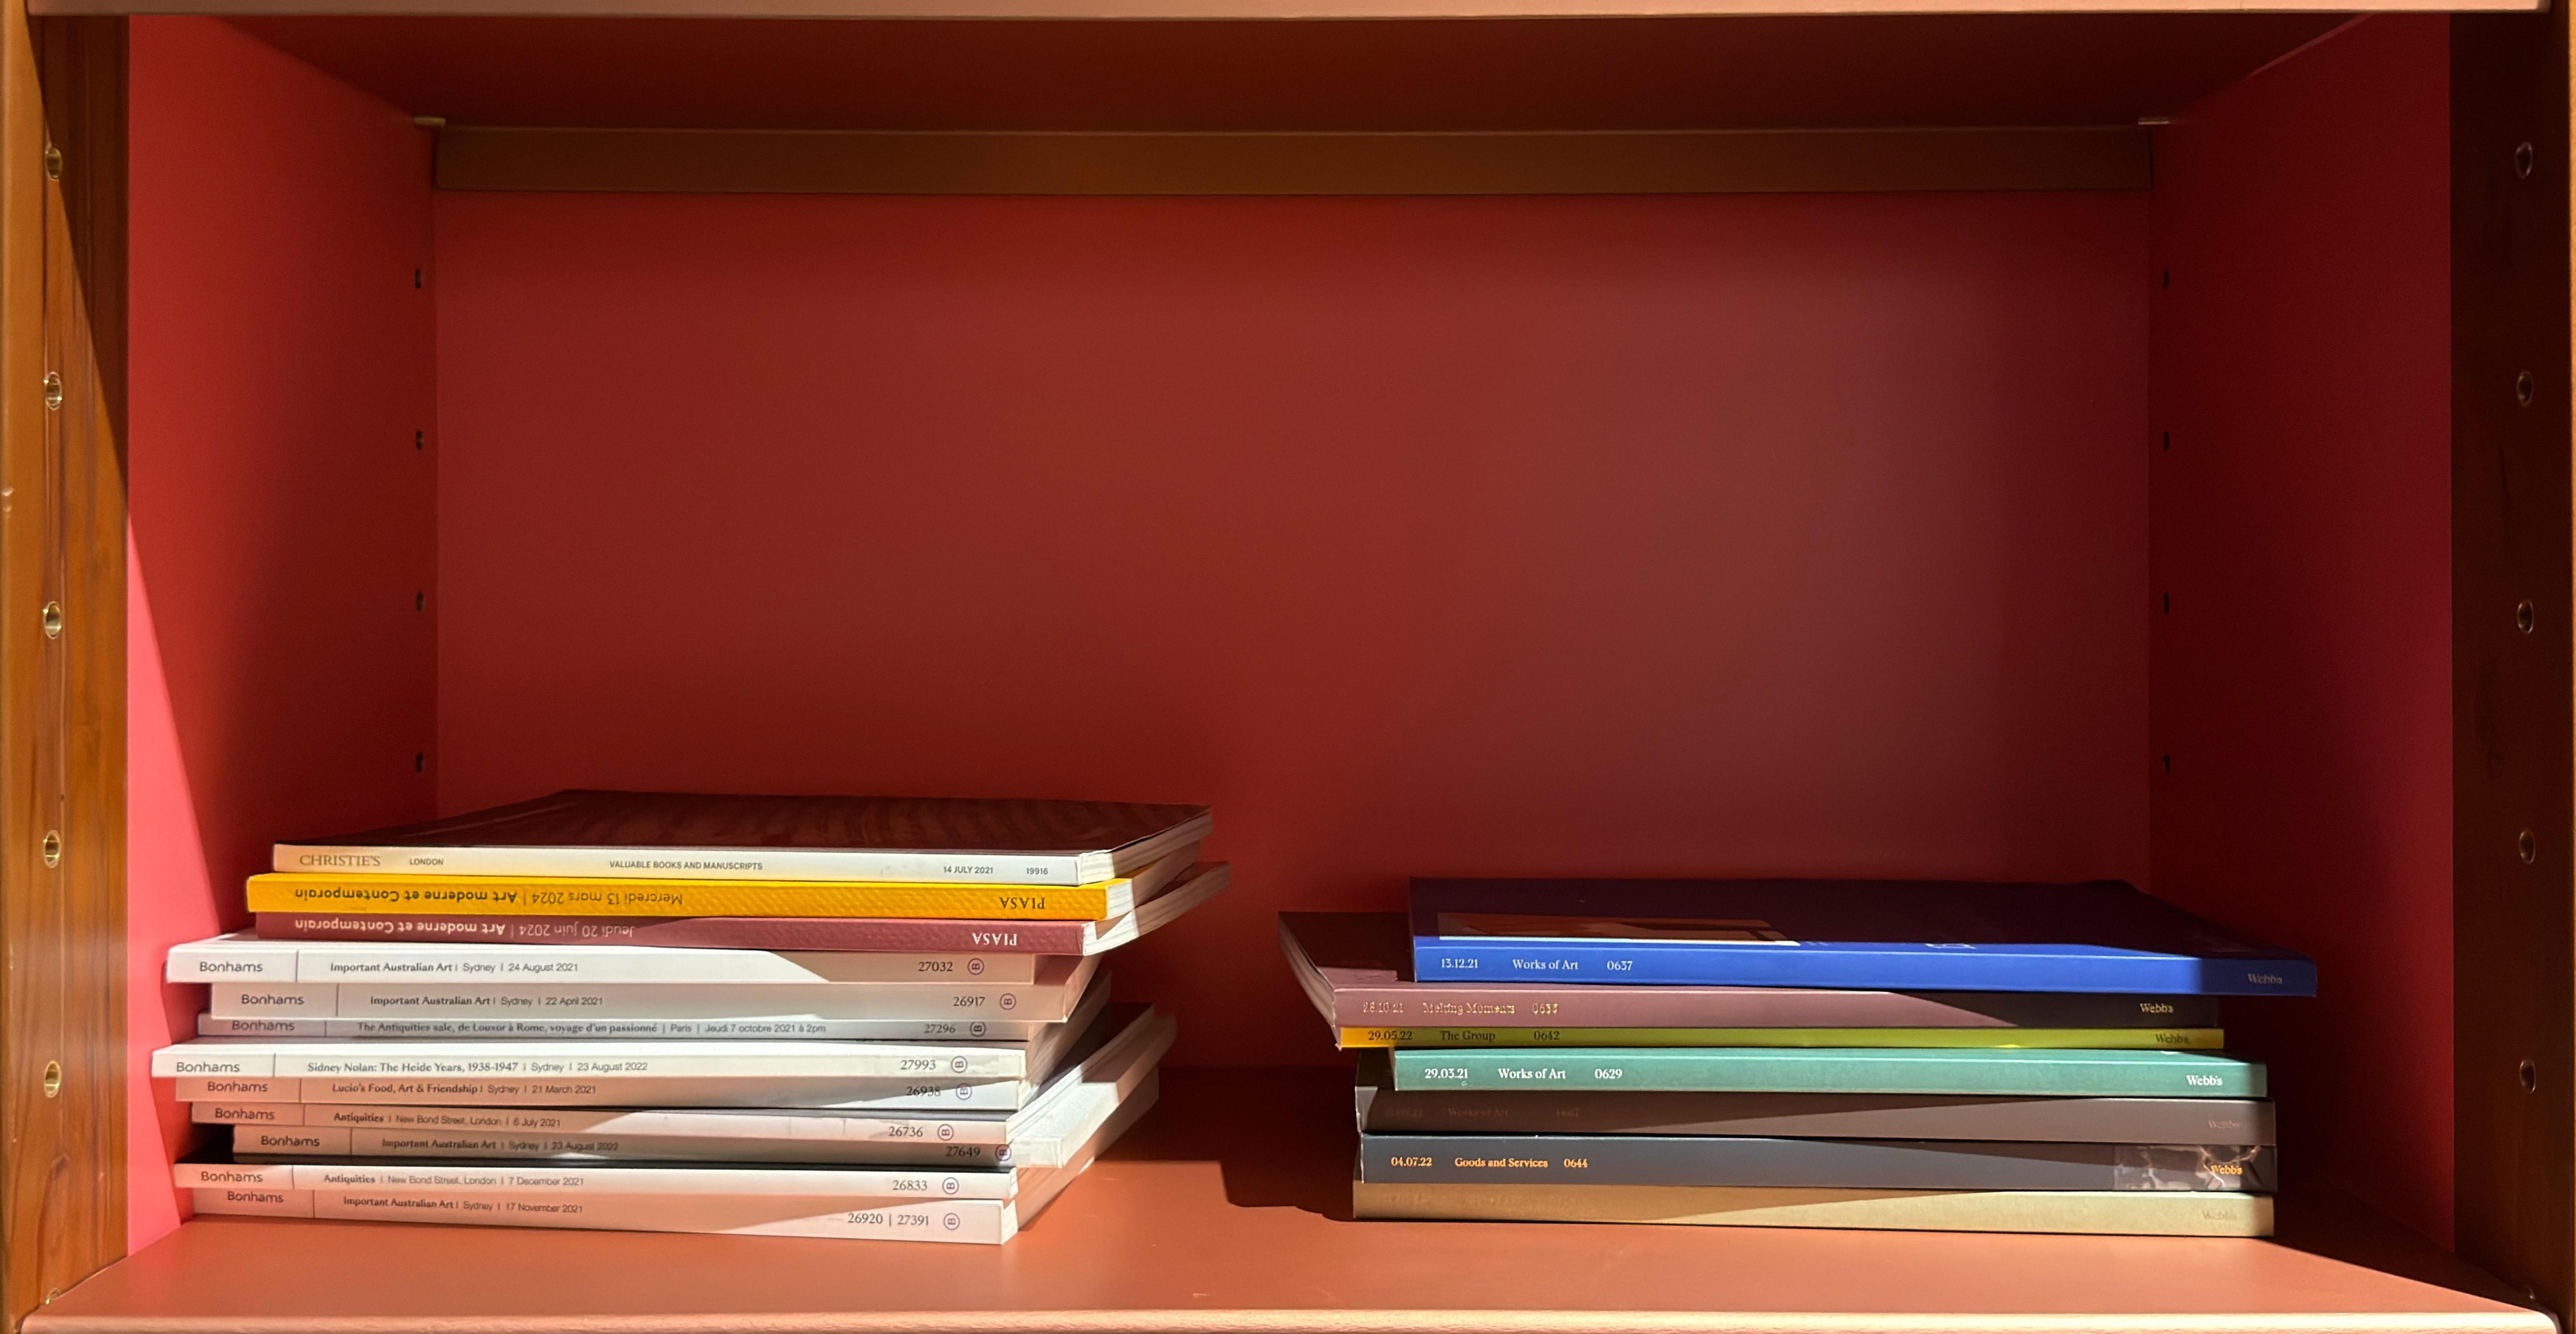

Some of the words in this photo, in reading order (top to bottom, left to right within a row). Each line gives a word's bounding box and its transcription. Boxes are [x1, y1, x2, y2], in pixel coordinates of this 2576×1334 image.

[300, 855, 380, 866] CHRISTIE'S
[295, 887, 399, 902] Contemporain
[405, 890, 419, 900] et
[425, 890, 487, 902] moderne
[493, 891, 517, 902] Art
[532, 894, 563, 904] 2024
[607, 893, 619, 904] 13
[624, 893, 682, 904] Mercredi
[1000, 897, 1045, 909] PIASA
[295, 918, 393, 933] Contemporain
[399, 922, 412, 931] et
[417, 922, 477, 934] moderne
[482, 924, 505, 935] Art
[520, 924, 550, 935] 2024
[555, 921, 579, 935] juin
[582, 926, 598, 937] 20
[602, 927, 634, 937] Jeudi
[973, 933, 1017, 946] PIASA
[199, 962, 263, 972] Bonhams
[330, 962, 380, 972] Important
[463, 963, 495, 973] Sydney
[508, 963, 520, 971] 24
[522, 963, 553, 973] August
[918, 962, 953, 972] 27032
[1441, 958, 1478, 968] 13.12.21
[1513, 959, 1545, 970] Works
[1549, 960, 1560, 970] of
[1562, 960, 1578, 970] Art
[1607, 961, 1633, 971] 0637
[241, 994, 304, 1005] Bonhams
[371, 996, 419, 1006] Important
[501, 997, 532, 1006] Sydney
[559, 997, 579, 1006] April
[953, 996, 985, 1006] 26917
[2140, 1003, 2173, 1013] Webb's
[232, 1020, 294, 1031] Bonhams
[378, 1023, 430, 1032] Antiquities
[517, 1023, 547, 1033] Rome,
[550, 1024, 583, 1033] voyage
[807, 1025, 826, 1033] 2pm
[924, 1024, 955, 1033] 27296
[1368, 1030, 1412, 1041] 29.05.22
[1440, 1031, 1460, 1040] The
[1463, 1031, 1495, 1042] Group
[176, 1062, 240, 1072] Bonhams
[308, 1063, 341, 1072] Sidney
[434, 1063, 465, 1072] Years,
[532, 1063, 564, 1072] Sydney
[591, 1063, 622, 1072] August
[900, 1060, 936, 1070] 27993
[1425, 1068, 1468, 1079] 29.03.21
[1498, 1068, 1532, 1078] Works
[1536, 1068, 1547, 1078] of
[1549, 1068, 1565, 1079] Art
[1595, 1069, 1622, 1079] 0629
[2186, 1075, 2222, 1086] Webb's
[207, 1082, 267, 1092] Bonhams
[368, 1084, 395, 1093] Food,
[427, 1084, 477, 1094] Friendship
[488, 1085, 519, 1094] Sydney
[906, 1086, 940, 1096] 26938
[215, 1109, 274, 1119] Bonhams
[334, 1113, 383, 1123] Antiquities
[396, 1114, 414, 1123] New
[417, 1115, 438, 1123] Bond
[470, 1116, 501, 1125] London
[514, 1117, 519, 1126] 6
[521, 1117, 538, 1127] July
[540, 1118, 560, 1127] 2021
[889, 1127, 923, 1136] 26736
[261, 1135, 320, 1146] Bonhams
[382, 1139, 429, 1149] Important
[432, 1139, 478, 1148] Australian
[509, 1141, 538, 1150] Sydney
[566, 1142, 594, 1151] August
[946, 1146, 980, 1156] 27649
[1391, 1157, 1432, 1167] 04.07.22
[1455, 1158, 1485, 1167] Goods
[1488, 1158, 1505, 1167] and
[1509, 1158, 1548, 1168] Services
[1564, 1158, 1588, 1168] 0644
[2211, 1165, 2242, 1175] Webb's
[201, 1171, 263, 1182] Bonhams
[324, 1174, 375, 1184] Antiquities
[388, 1175, 406, 1183] New
[892, 1180, 927, 1190] 26833
[227, 1191, 283, 1203] Bonhams
[344, 1197, 388, 1207] Important
[391, 1199, 437, 1208] Australian
[464, 1201, 493, 1210] Sydney
[848, 1213, 883, 1224] 26920
[897, 1215, 929, 1226] 27391
